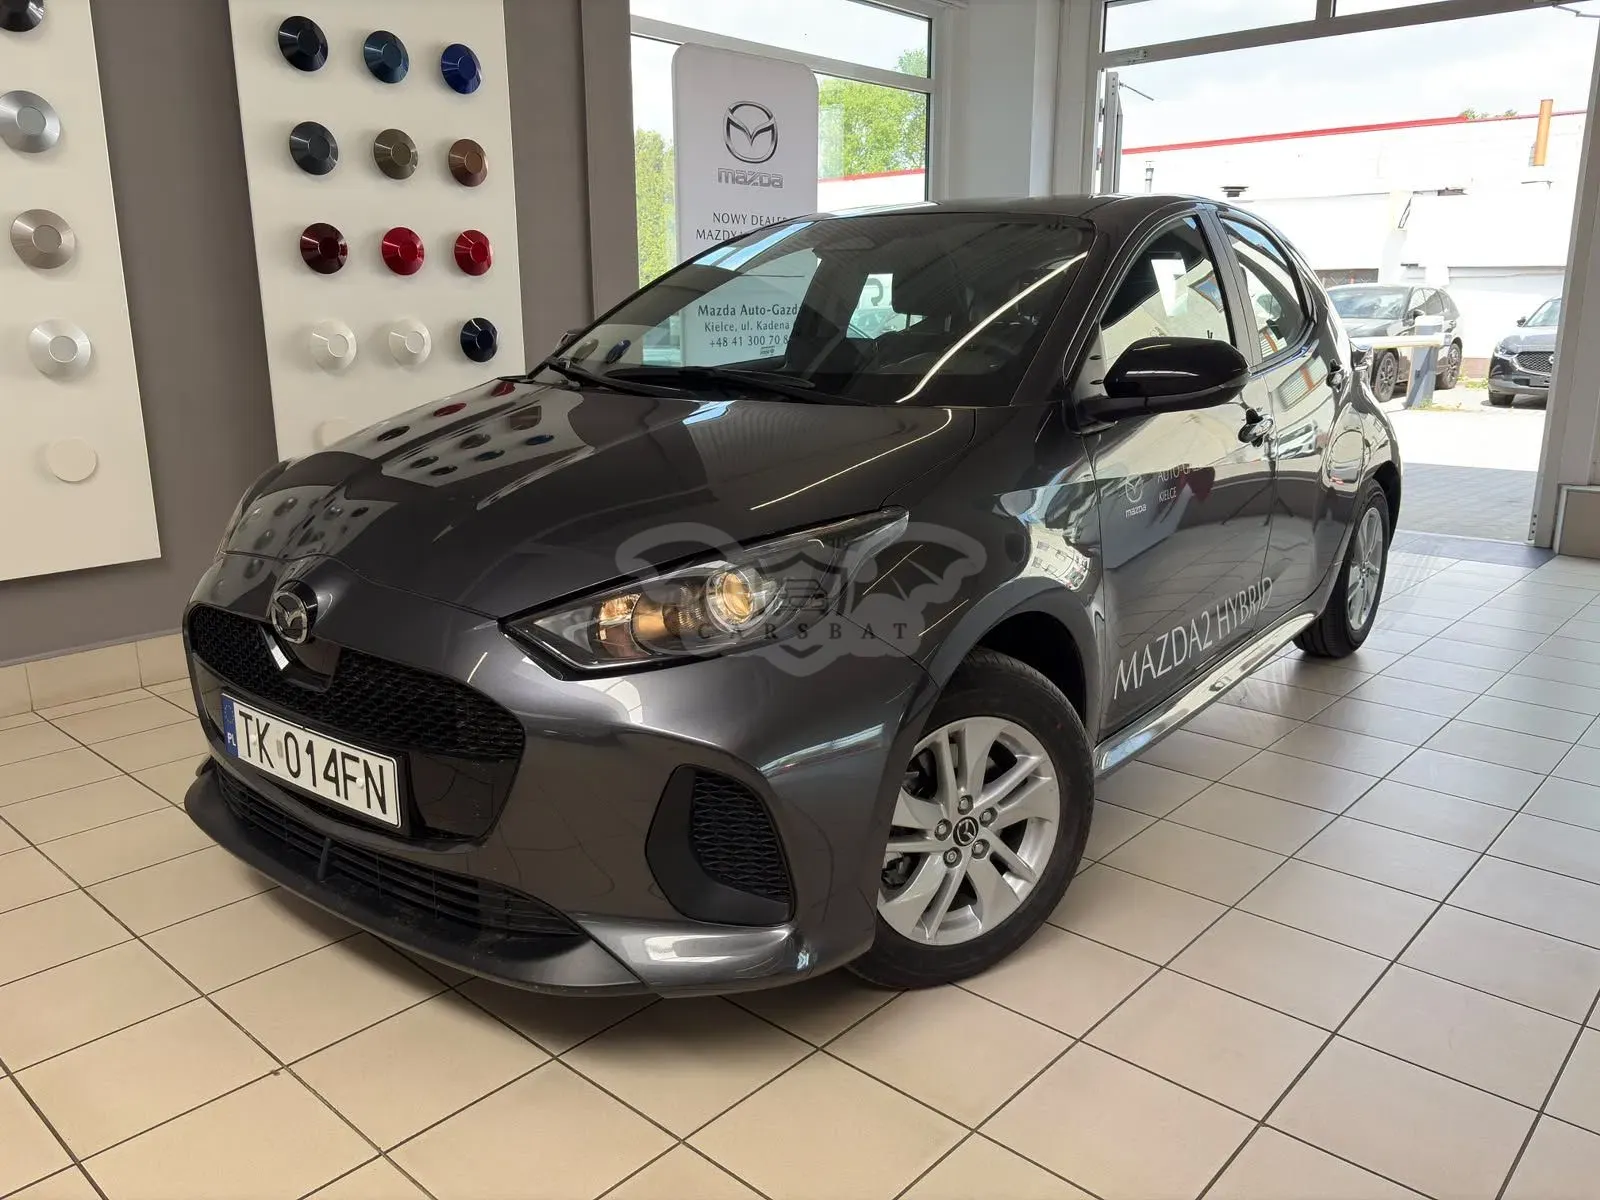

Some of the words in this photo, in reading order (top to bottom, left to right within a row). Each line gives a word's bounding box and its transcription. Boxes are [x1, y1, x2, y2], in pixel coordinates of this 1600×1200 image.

[713, 212, 748, 225] NOWY
[696, 229, 737, 241] MAZDY
[698, 304, 736, 317] Mazda
[740, 303, 800, 316] Auto-Gazd
[704, 322, 738, 333] Kielce,
[741, 321, 753, 331] ul.
[756, 320, 790, 331] Kadena
[710, 336, 729, 348] +48
[731, 336, 743, 347] 41
[747, 335, 765, 346] 300
[768, 335, 781, 345] 70
[1159, 486, 1177, 503] KIELCE
[1113, 610, 1213, 700] MAZDA2
[1216, 576, 1273, 640] HYBRID
[227, 731, 237, 747] PL
[238, 709, 275, 769] TK
[283, 730, 388, 815] 014FN
